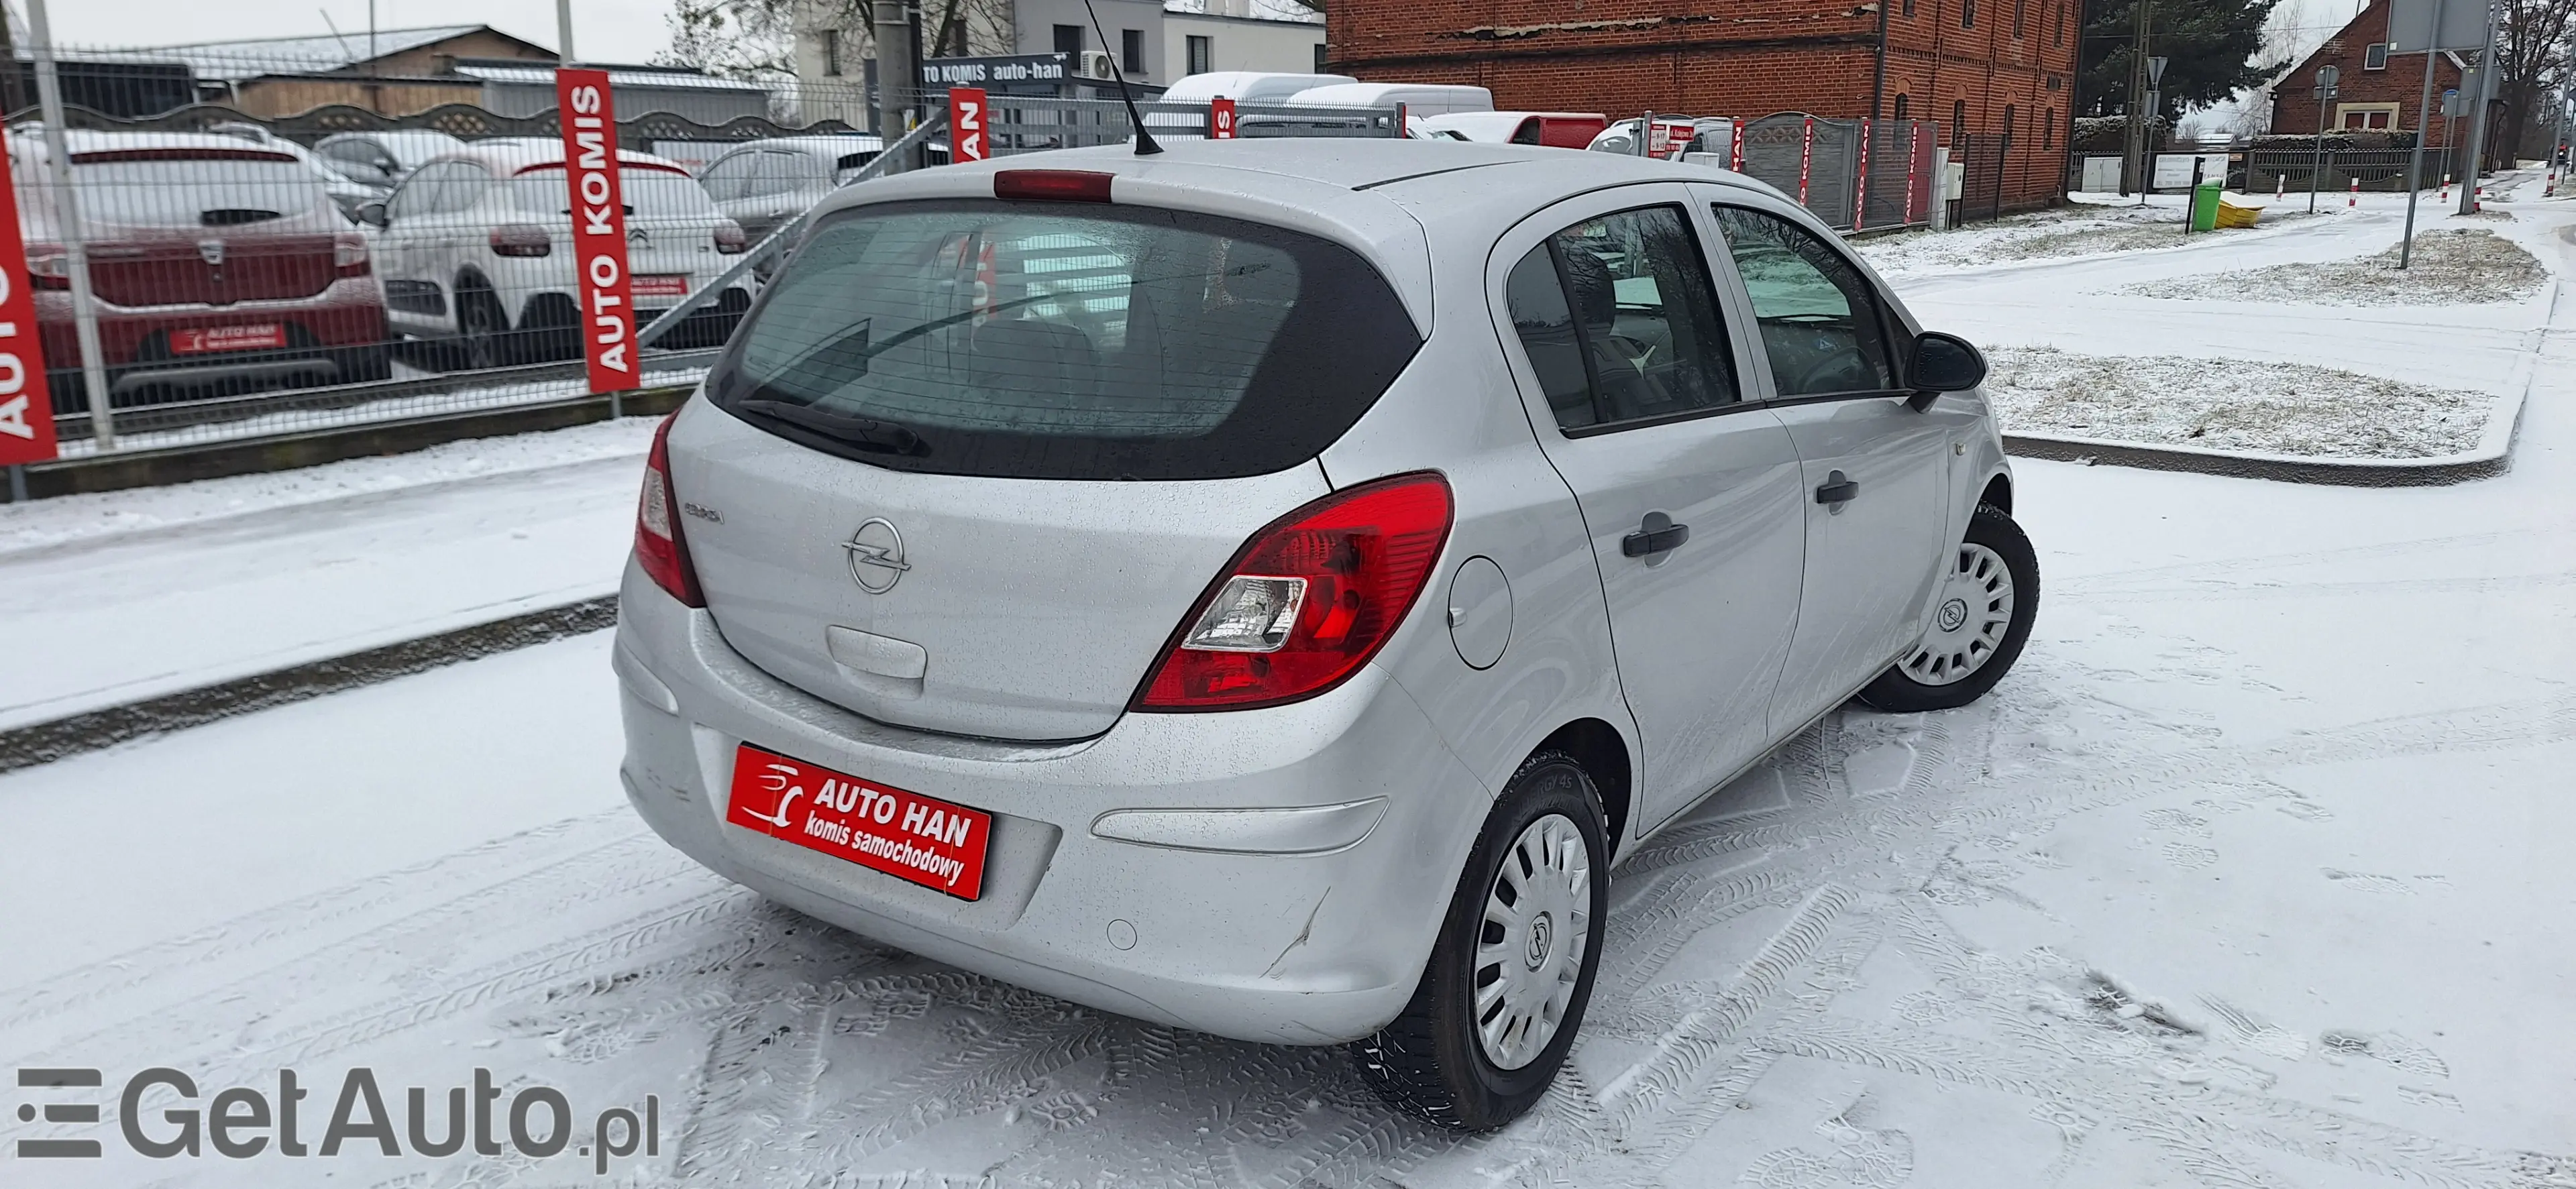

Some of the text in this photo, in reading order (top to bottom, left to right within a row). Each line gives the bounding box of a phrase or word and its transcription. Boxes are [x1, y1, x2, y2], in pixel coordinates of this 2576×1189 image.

[923, 62, 1063, 83] TO KOMIS auto-han
[1733, 127, 1741, 171] HAN
[1803, 125, 1811, 180] KOMIS
[1909, 127, 1917, 174] KOMIS
[570, 85, 629, 373] AUTO KOMIS
[814, 778, 972, 848] AUTO HAN
[804, 810, 965, 887] komis samochodowy
